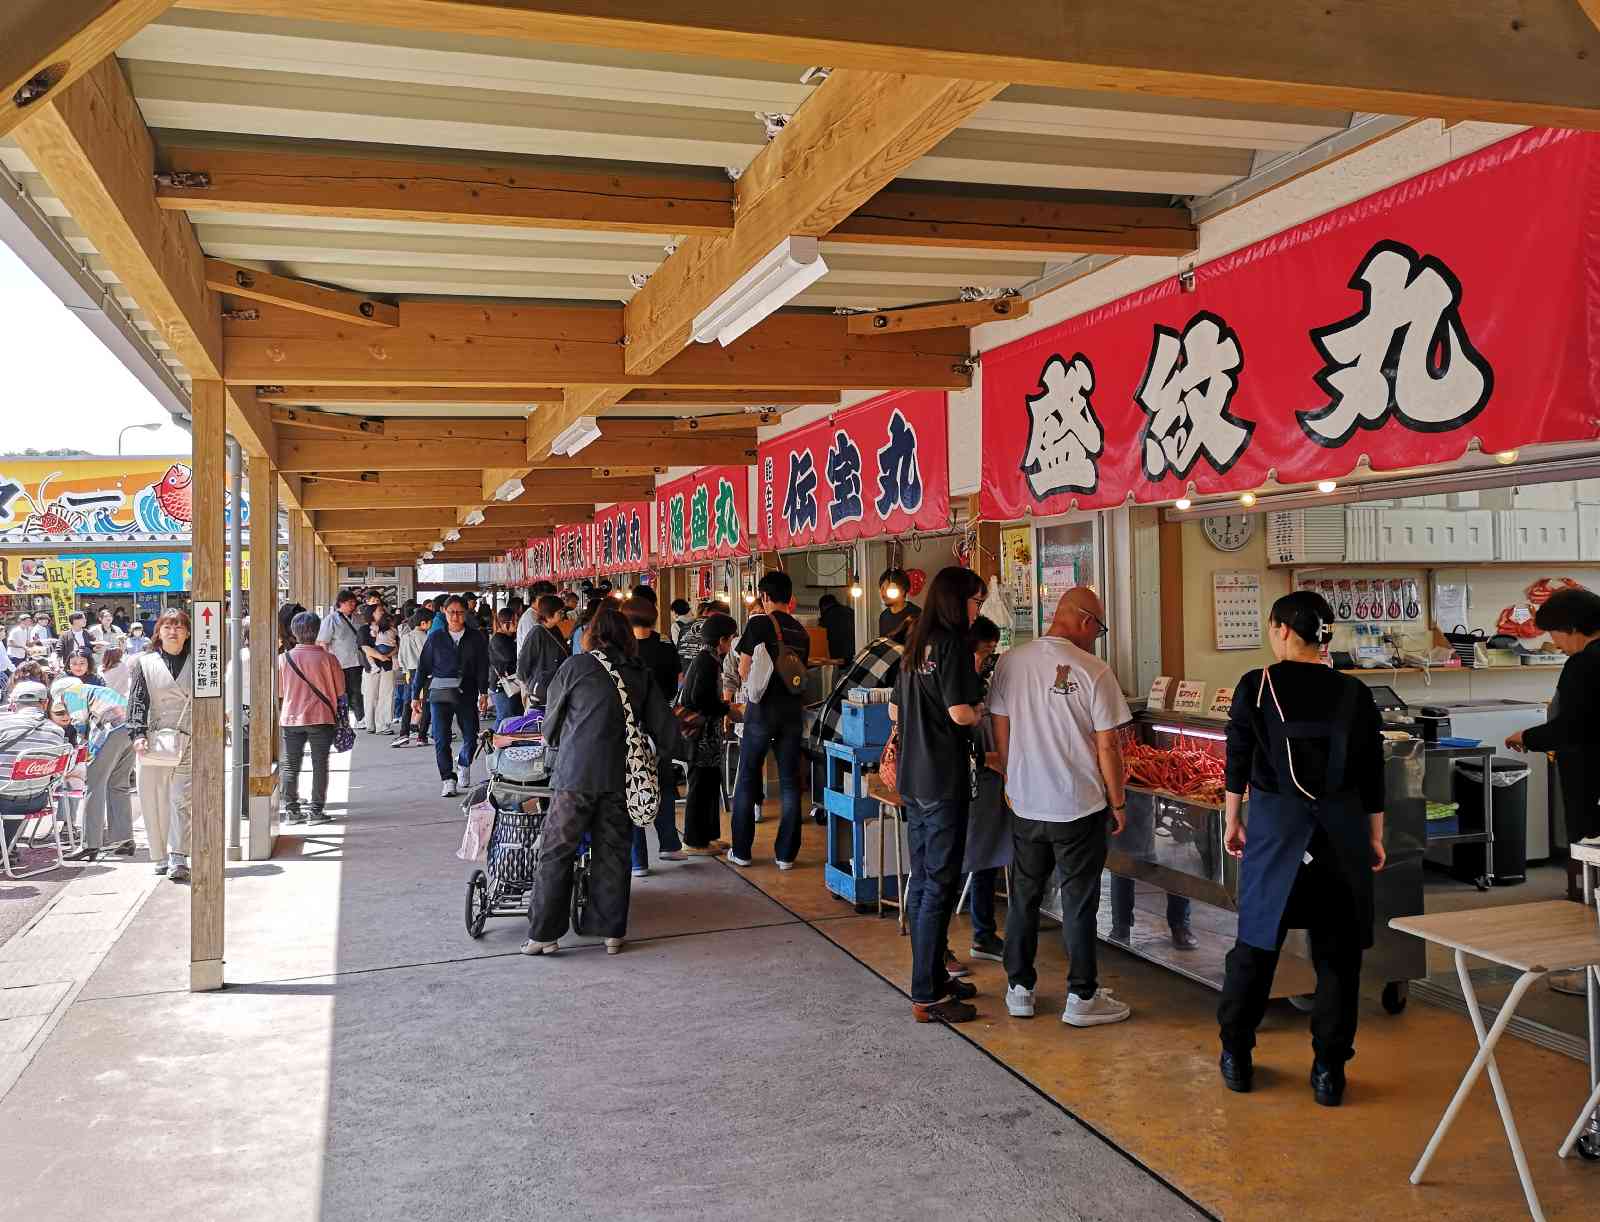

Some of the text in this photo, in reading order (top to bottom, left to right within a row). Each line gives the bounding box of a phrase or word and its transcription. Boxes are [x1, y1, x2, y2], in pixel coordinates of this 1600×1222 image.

[1020, 238, 1494, 501] 盛紋丸
[782, 407, 923, 537] 伝宝丸
[140, 558, 171, 588] 正
